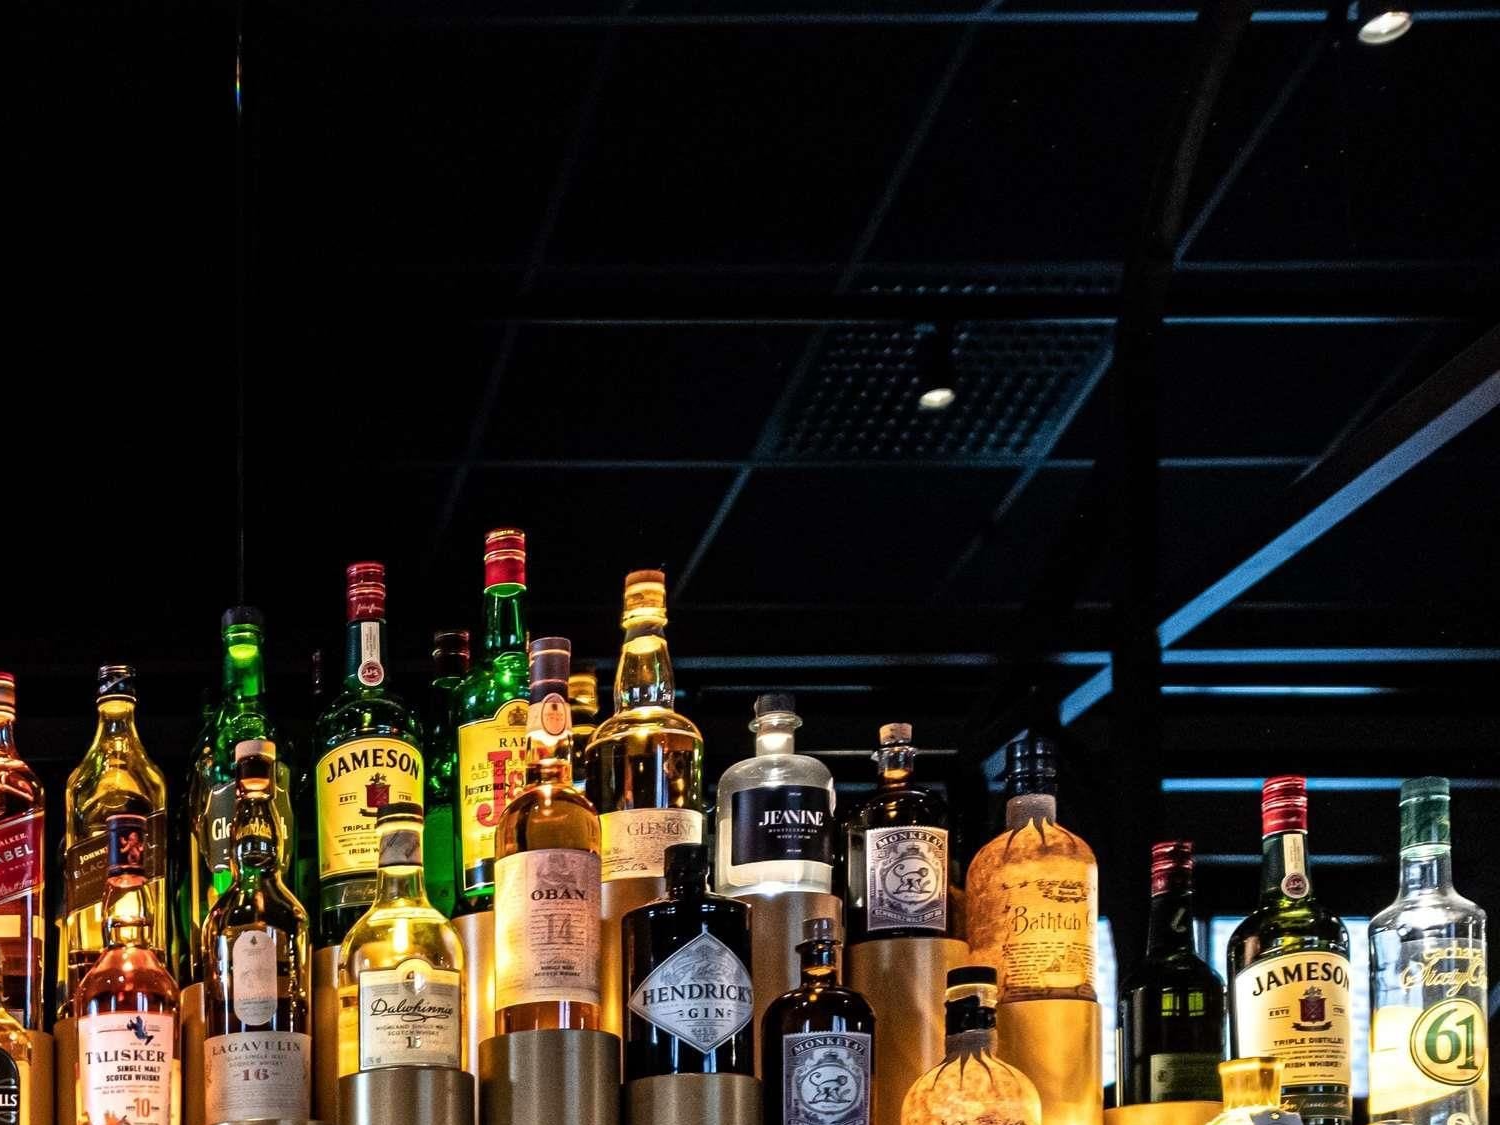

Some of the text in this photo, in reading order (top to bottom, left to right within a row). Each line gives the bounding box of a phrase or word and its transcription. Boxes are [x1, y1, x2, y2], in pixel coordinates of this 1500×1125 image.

[326, 748, 420, 783] JAMESON
[758, 809, 824, 826] JEANINE
[876, 832, 932, 848] MONKEY
[531, 888, 588, 901] OBAN
[1012, 905, 1081, 936] Bathtub
[1252, 962, 1350, 997] JAMESON
[370, 998, 453, 1019] Dalwhinnie
[688, 1007, 724, 1018] GIN
[793, 1037, 850, 1054] MONKEY
[1273, 1037, 1306, 1046] TRIPLE
[1425, 1008, 1478, 1070] 61
[212, 1041, 301, 1056] LAGAVULIN
[85, 1049, 166, 1065] TALISKER
[1285, 1060, 1306, 1069] RISH
[117, 1065, 141, 1073] SINGLE
[242, 1069, 270, 1081] 16
[106, 1074, 133, 1082] SCOTCH
[133, 1097, 150, 1118] 10
